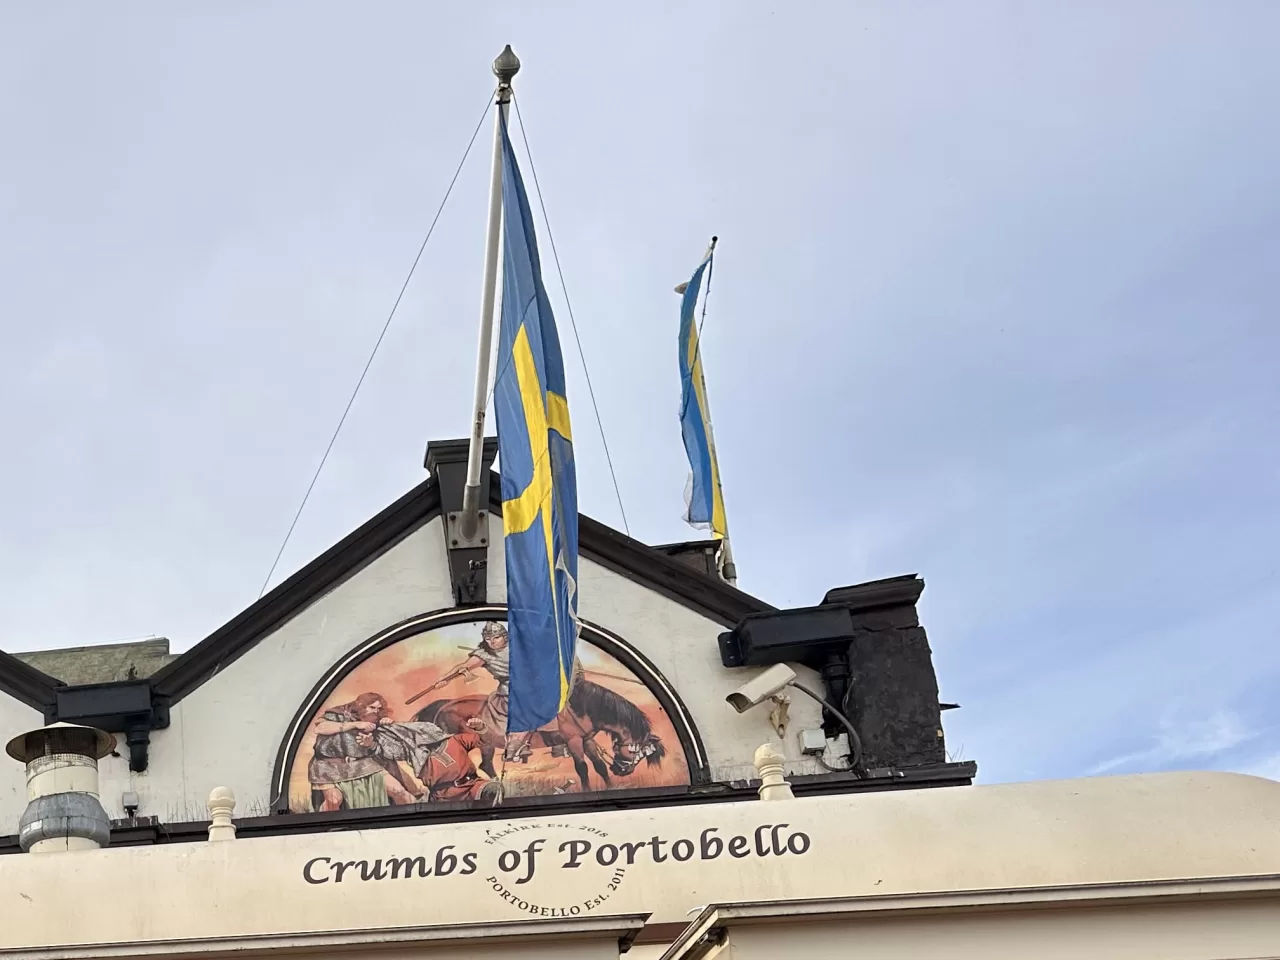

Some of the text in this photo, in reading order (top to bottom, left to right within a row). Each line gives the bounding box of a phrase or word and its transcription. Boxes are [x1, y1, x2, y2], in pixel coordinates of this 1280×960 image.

[303, 823, 811, 885] Crumbs of Portobello
[484, 823, 541, 845] FALKIRK
[578, 825, 609, 838] 2018
[486, 867, 626, 917] PORTOBELLO Est. 2011
